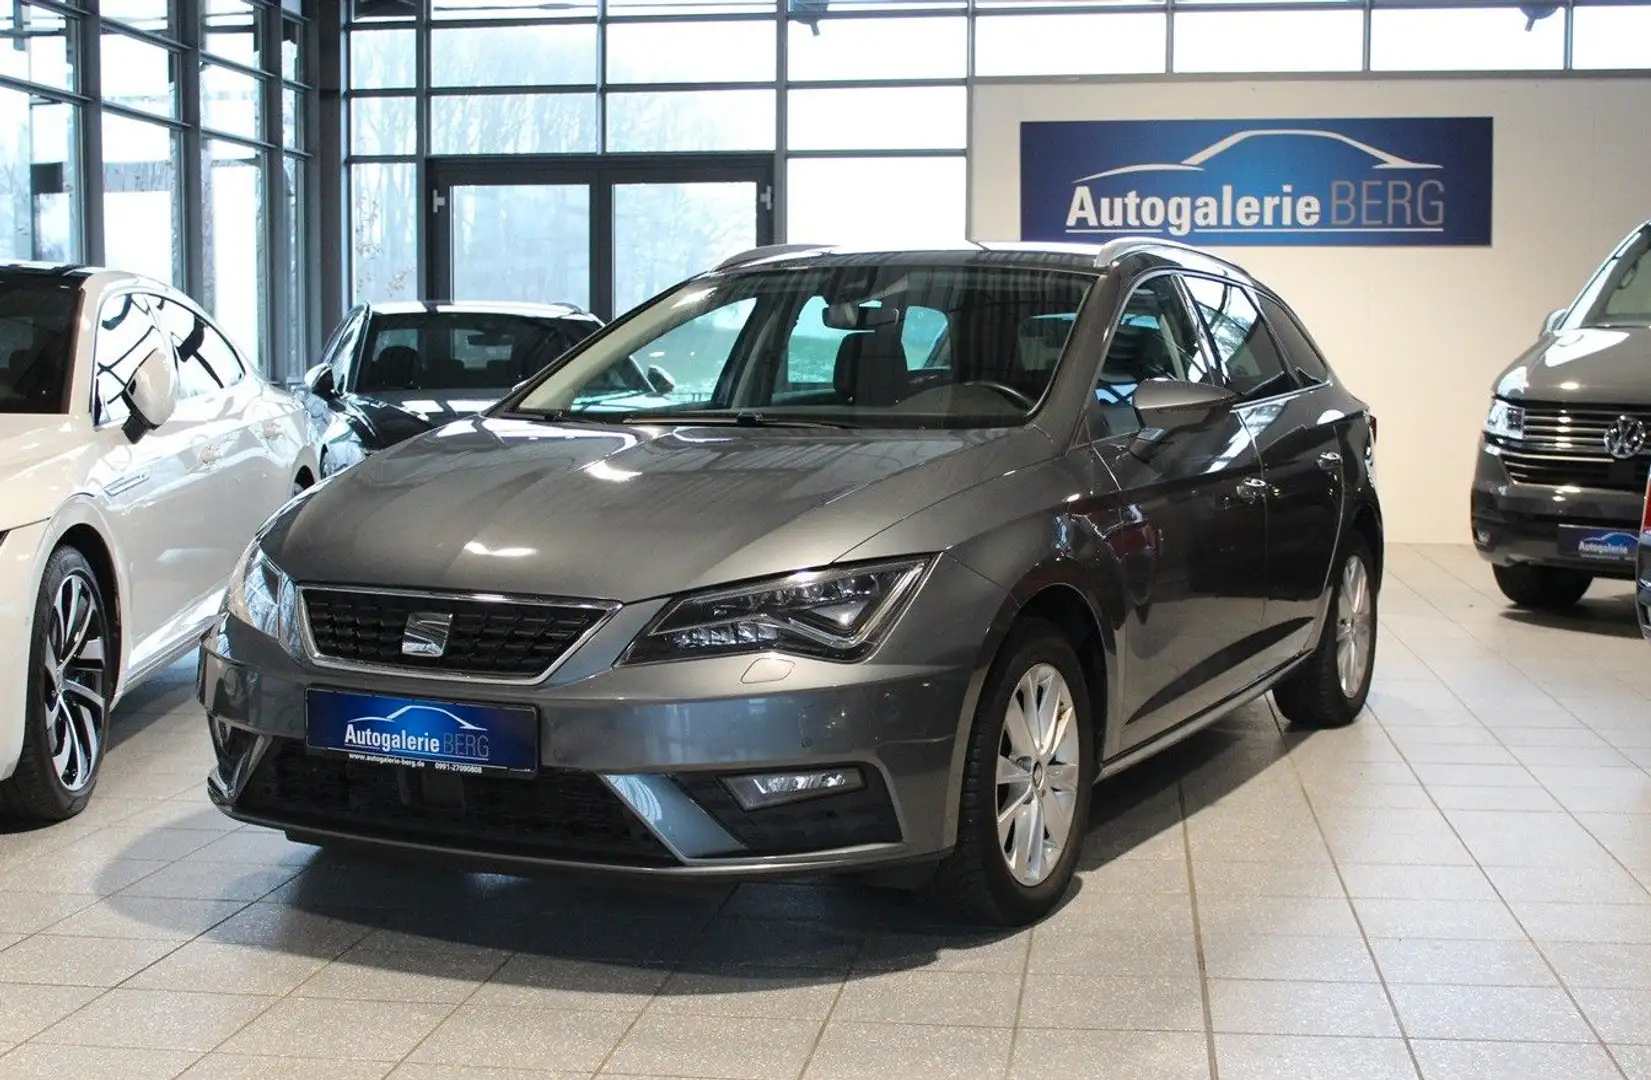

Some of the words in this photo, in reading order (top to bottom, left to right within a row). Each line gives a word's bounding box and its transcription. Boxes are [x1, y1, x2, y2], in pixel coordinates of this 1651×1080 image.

[1066, 185, 1320, 236] Autogalerie
[1331, 180, 1444, 226] BERG
[345, 724, 439, 753] Autogalerie
[443, 732, 489, 758] BERG
[349, 753, 425, 768] www.autogalerie-berg.de
